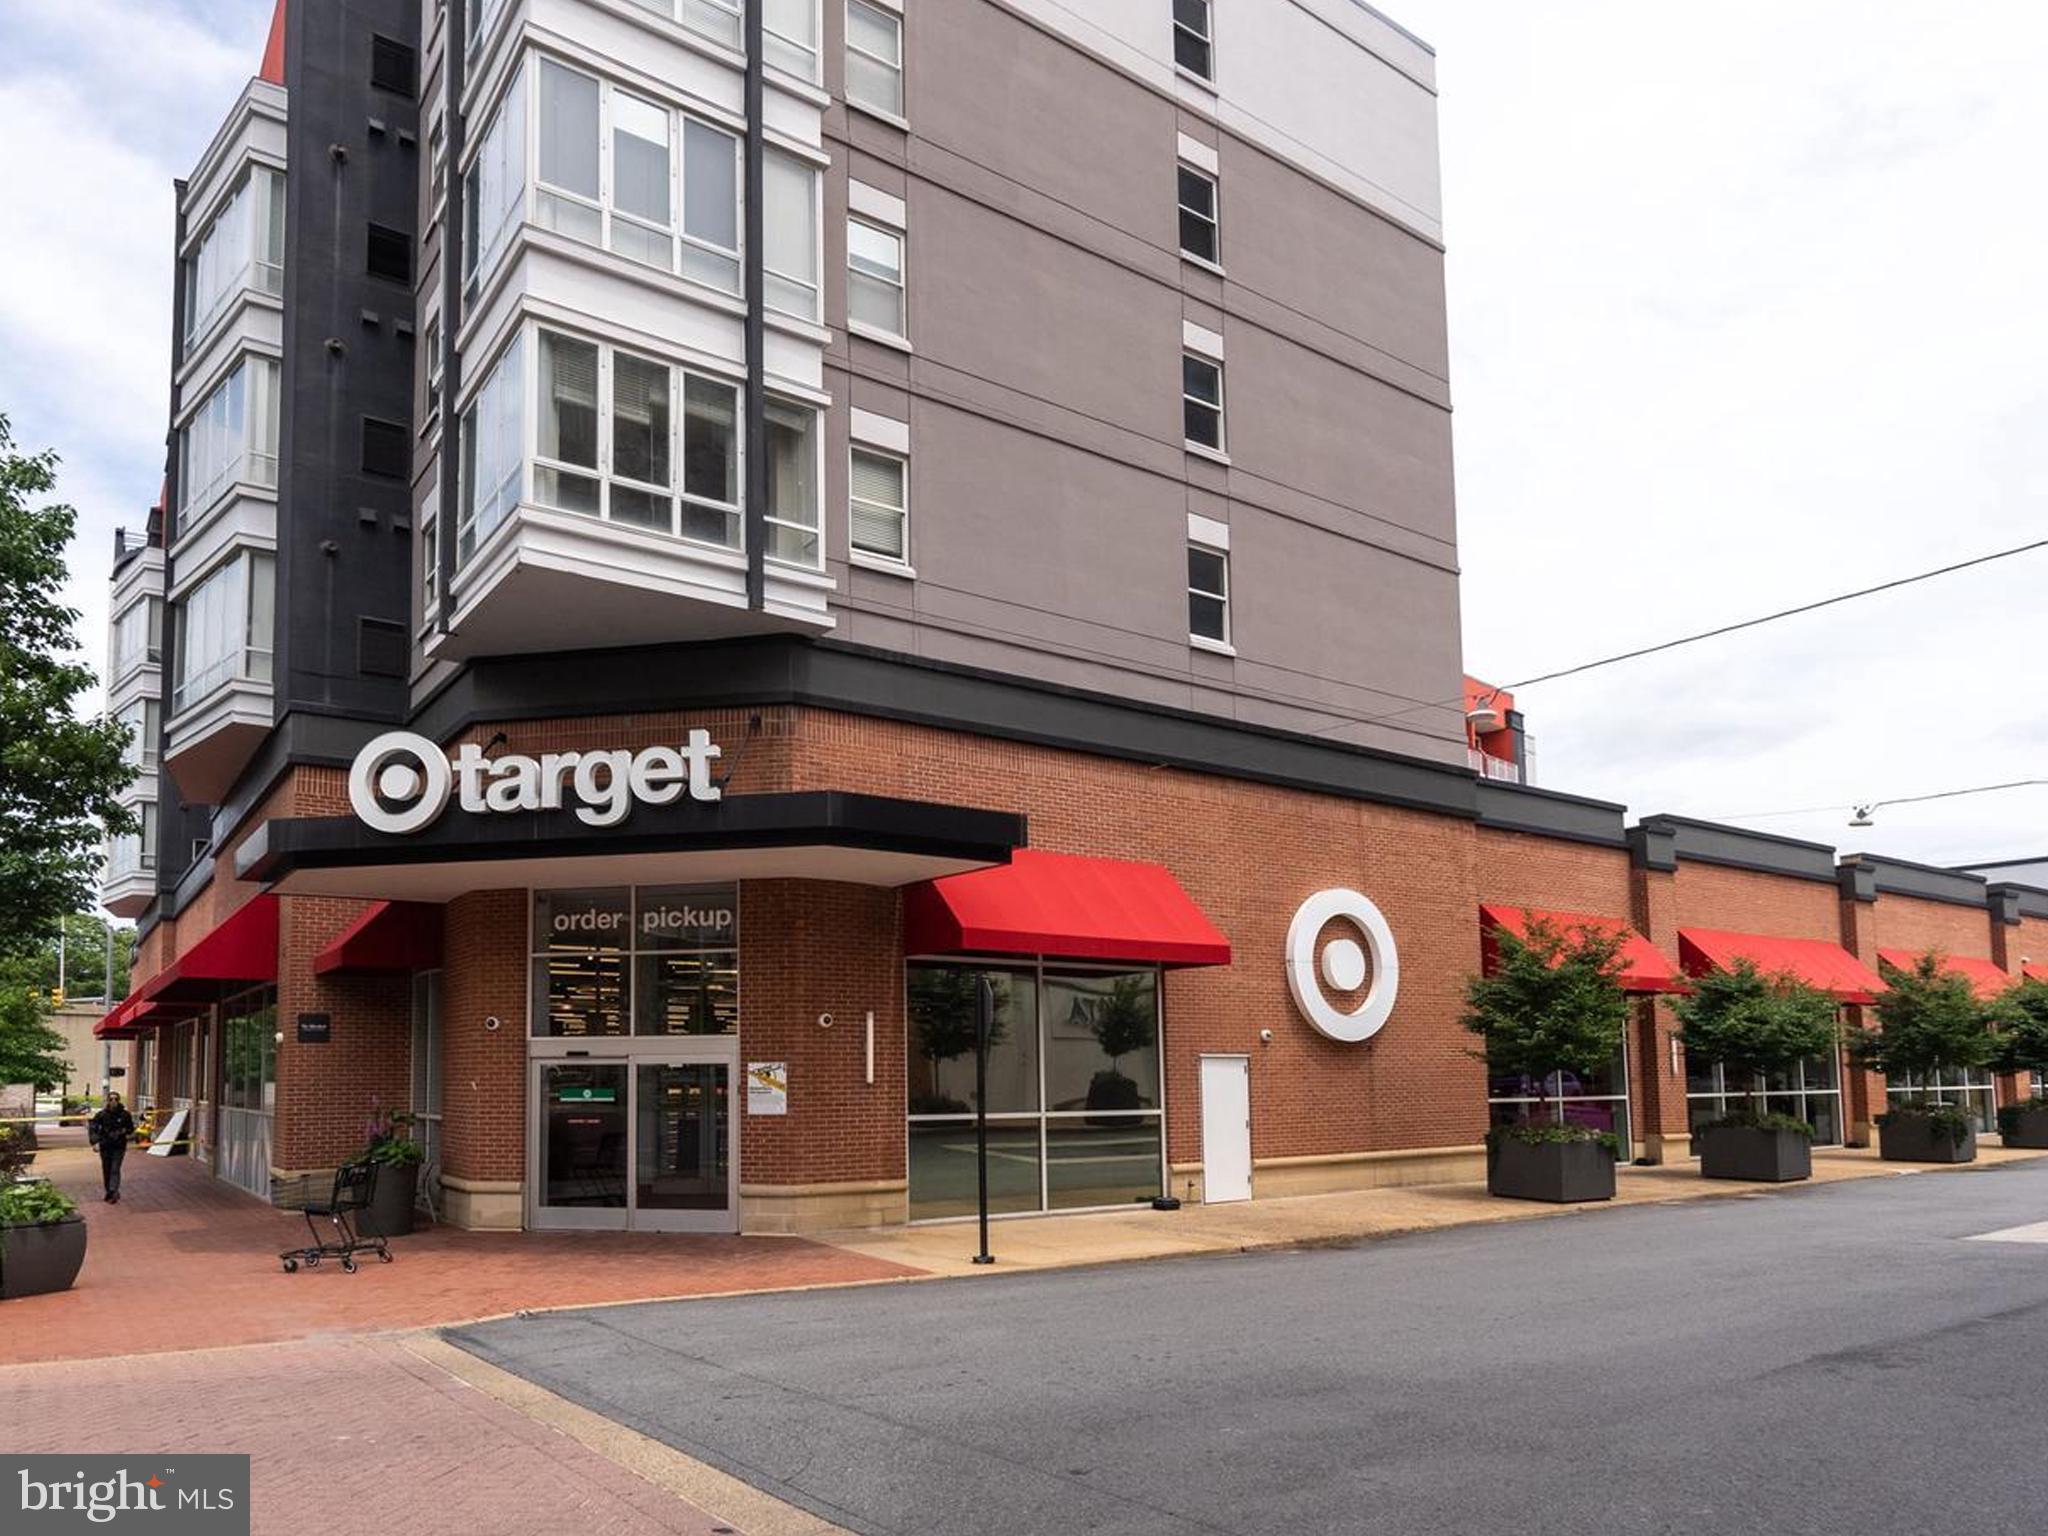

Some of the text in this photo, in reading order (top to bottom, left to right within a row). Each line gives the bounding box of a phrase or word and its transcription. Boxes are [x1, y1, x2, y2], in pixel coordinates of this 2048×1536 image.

[452, 729, 721, 827] target
[553, 905, 732, 933] order pickup
